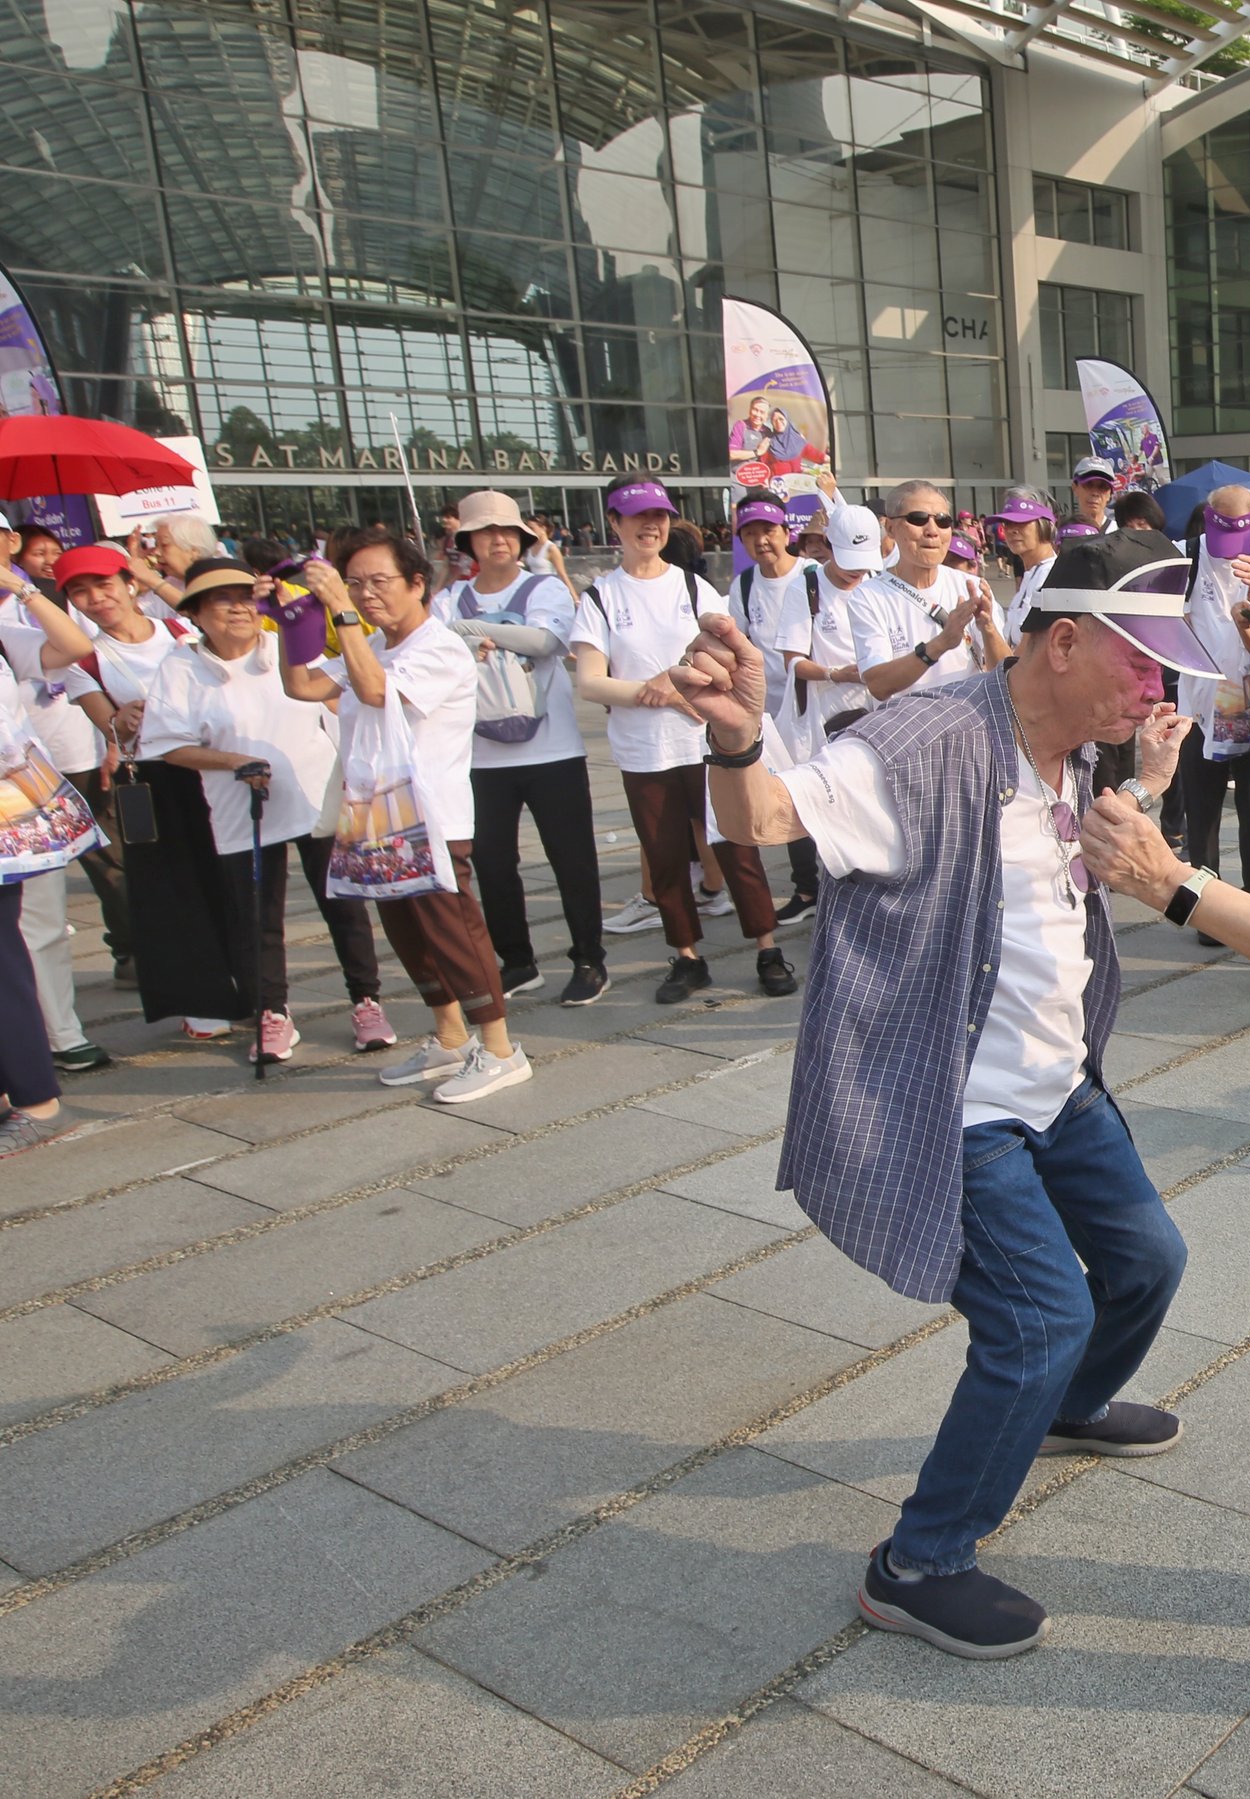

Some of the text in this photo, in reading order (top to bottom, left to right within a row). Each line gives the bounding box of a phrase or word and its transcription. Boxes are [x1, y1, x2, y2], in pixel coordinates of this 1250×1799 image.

[251, 444, 299, 468] AT
[319, 446, 476, 470] MARINA
[494, 449, 553, 471] BAY
[580, 452, 682, 472] SANDS
[142, 497, 176, 509] Bus 11
[889, 577, 928, 608] McDonald's
[808, 763, 836, 805] omseeds.sg
